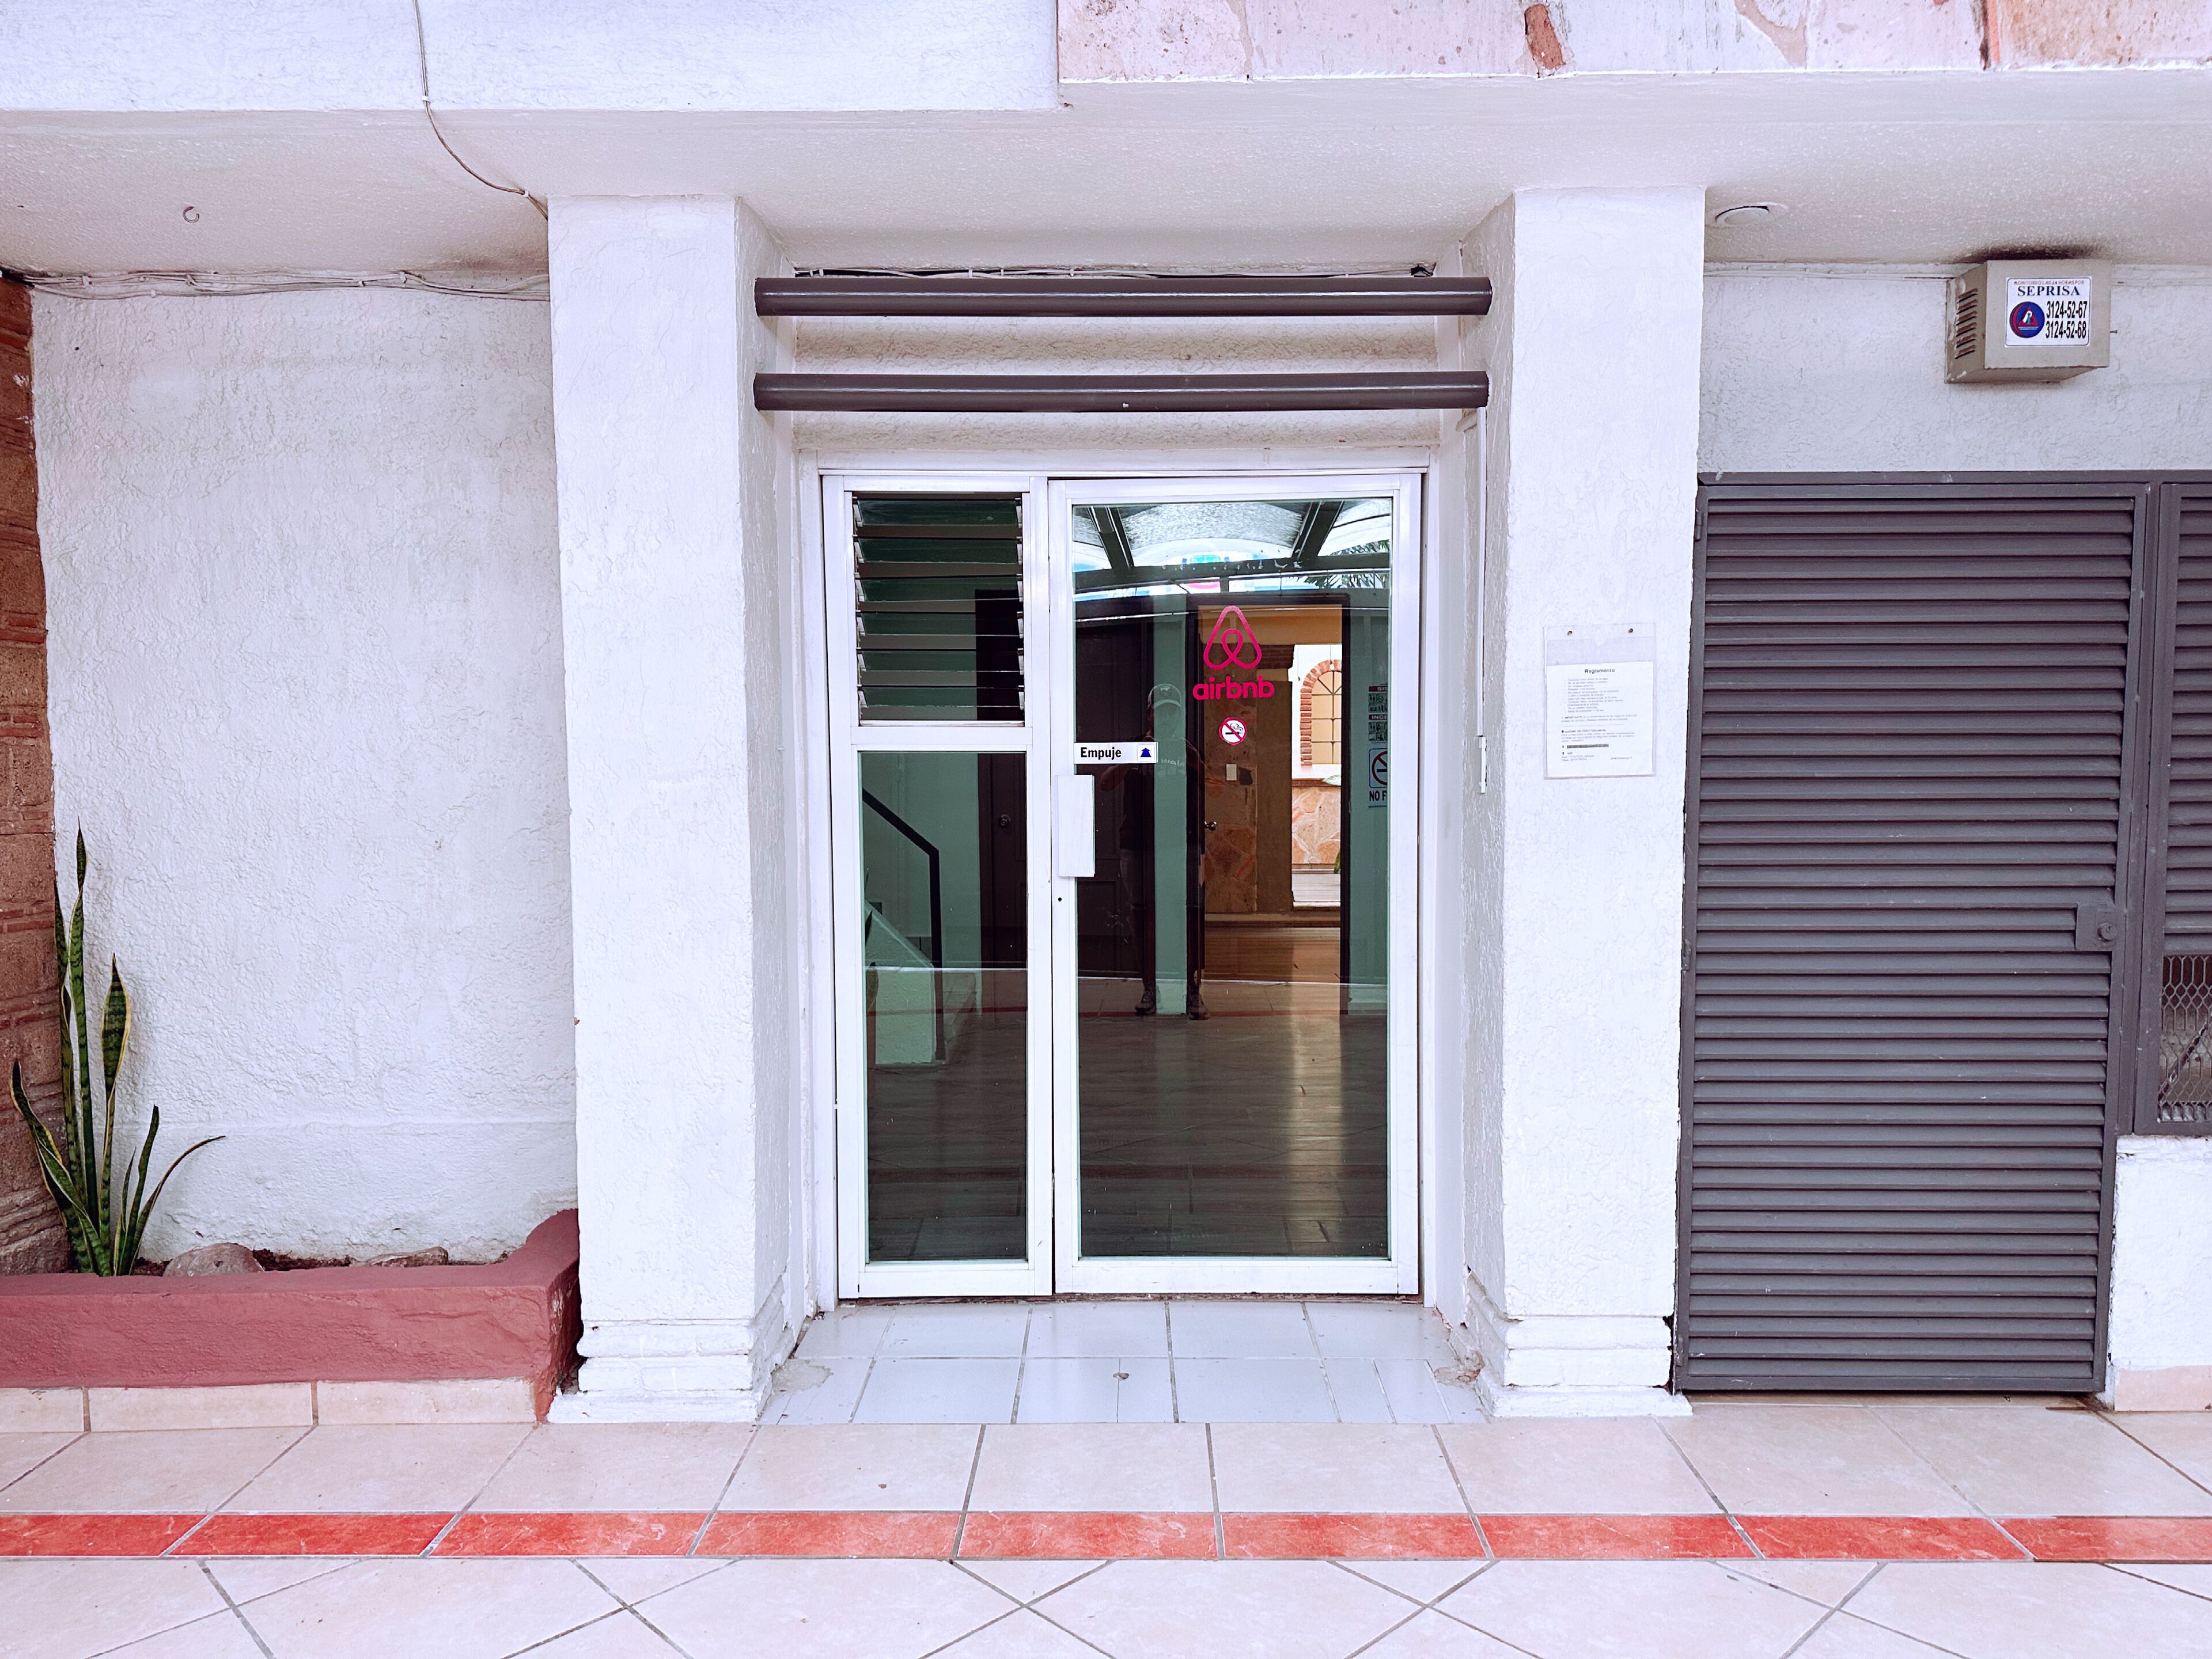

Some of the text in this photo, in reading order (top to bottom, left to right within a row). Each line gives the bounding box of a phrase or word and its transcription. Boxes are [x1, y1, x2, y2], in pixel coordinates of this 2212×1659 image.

[2017, 286, 2080, 296] SEPRISA
[2046, 301, 2088, 319] 3124-52-67
[2046, 320, 2086, 339] 3124-52-68
[1192, 674, 1275, 700] airbnb
[1081, 747, 1122, 760] Empuje
[1369, 790, 1380, 801] NO
